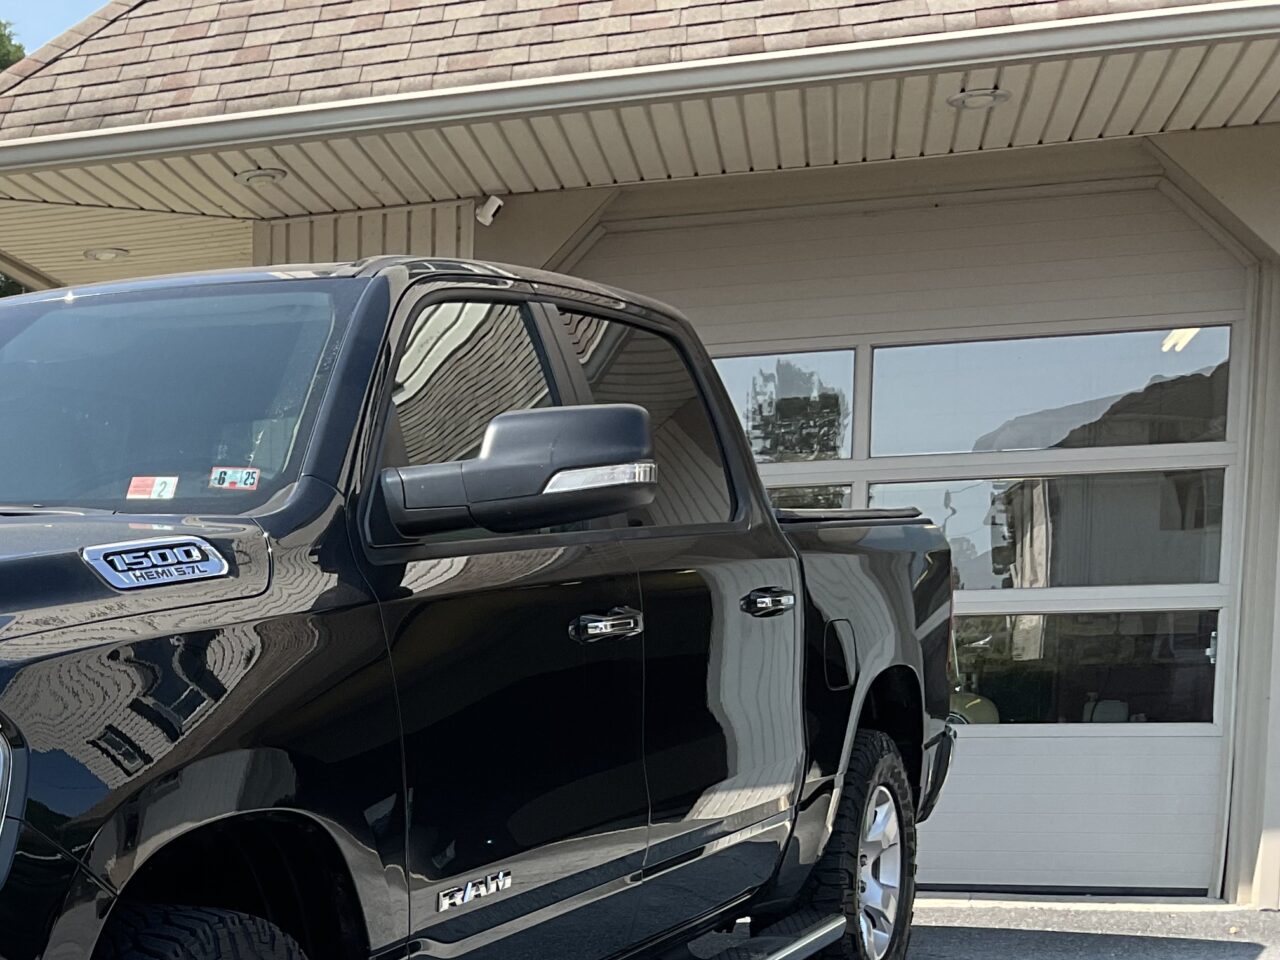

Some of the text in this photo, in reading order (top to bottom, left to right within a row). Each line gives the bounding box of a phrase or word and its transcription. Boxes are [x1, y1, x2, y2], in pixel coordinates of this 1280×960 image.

[217, 470, 256, 486] 6 25
[157, 480, 167, 498] 2
[107, 546, 202, 571] 1500
[132, 563, 208, 583] HEMI 5.7L
[436, 869, 512, 913] RAM
